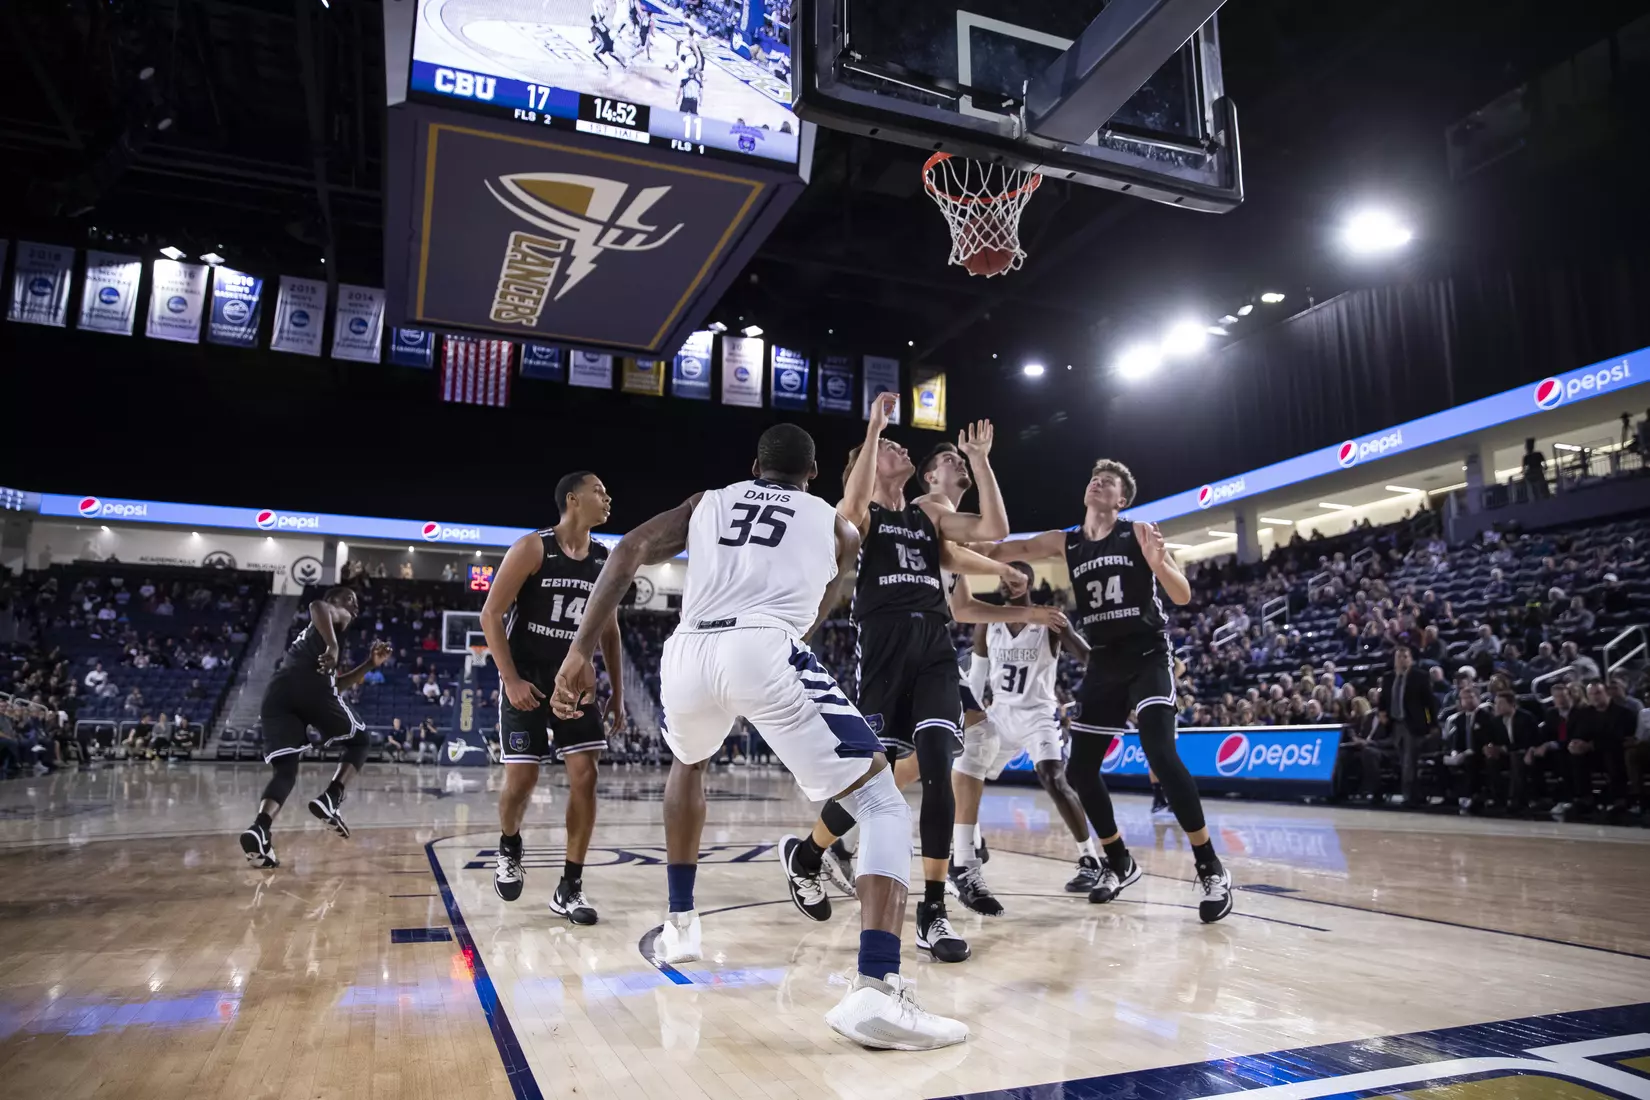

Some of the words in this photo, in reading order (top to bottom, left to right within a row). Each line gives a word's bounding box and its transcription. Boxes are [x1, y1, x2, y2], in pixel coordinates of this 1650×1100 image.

[434, 68, 496, 100] CBU
[527, 85, 550, 110] 17
[514, 109, 536, 122] FLS
[544, 113, 552, 125] 2
[593, 98, 637, 126] 14:52
[615, 127, 639, 141] HALF
[683, 115, 702, 141] 11
[671, 139, 692, 152] FLS
[290, 284, 317, 295] 2015
[489, 231, 568, 327] LANCERS
[347, 291, 374, 302] 2014
[1566, 359, 1630, 399] pepsi
[1360, 429, 1402, 459] pepsi
[744, 490, 791, 502] DAVIS
[1214, 476, 1245, 502] pepsi
[103, 502, 147, 516] pepsi
[278, 515, 318, 529] pepsi
[442, 527, 480, 540] pepsi
[718, 502, 796, 548] 35
[878, 524, 931, 541] CENTRAL
[895, 543, 927, 571] 15
[1073, 555, 1134, 578] CENTRAL
[471, 573, 490, 590] 25
[541, 578, 595, 592] CENTRA
[1086, 575, 1124, 609] 34
[551, 594, 587, 625] 14
[527, 621, 578, 640] ARKAN
[1001, 664, 1028, 694] 31
[1248, 738, 1322, 772] pepsi
